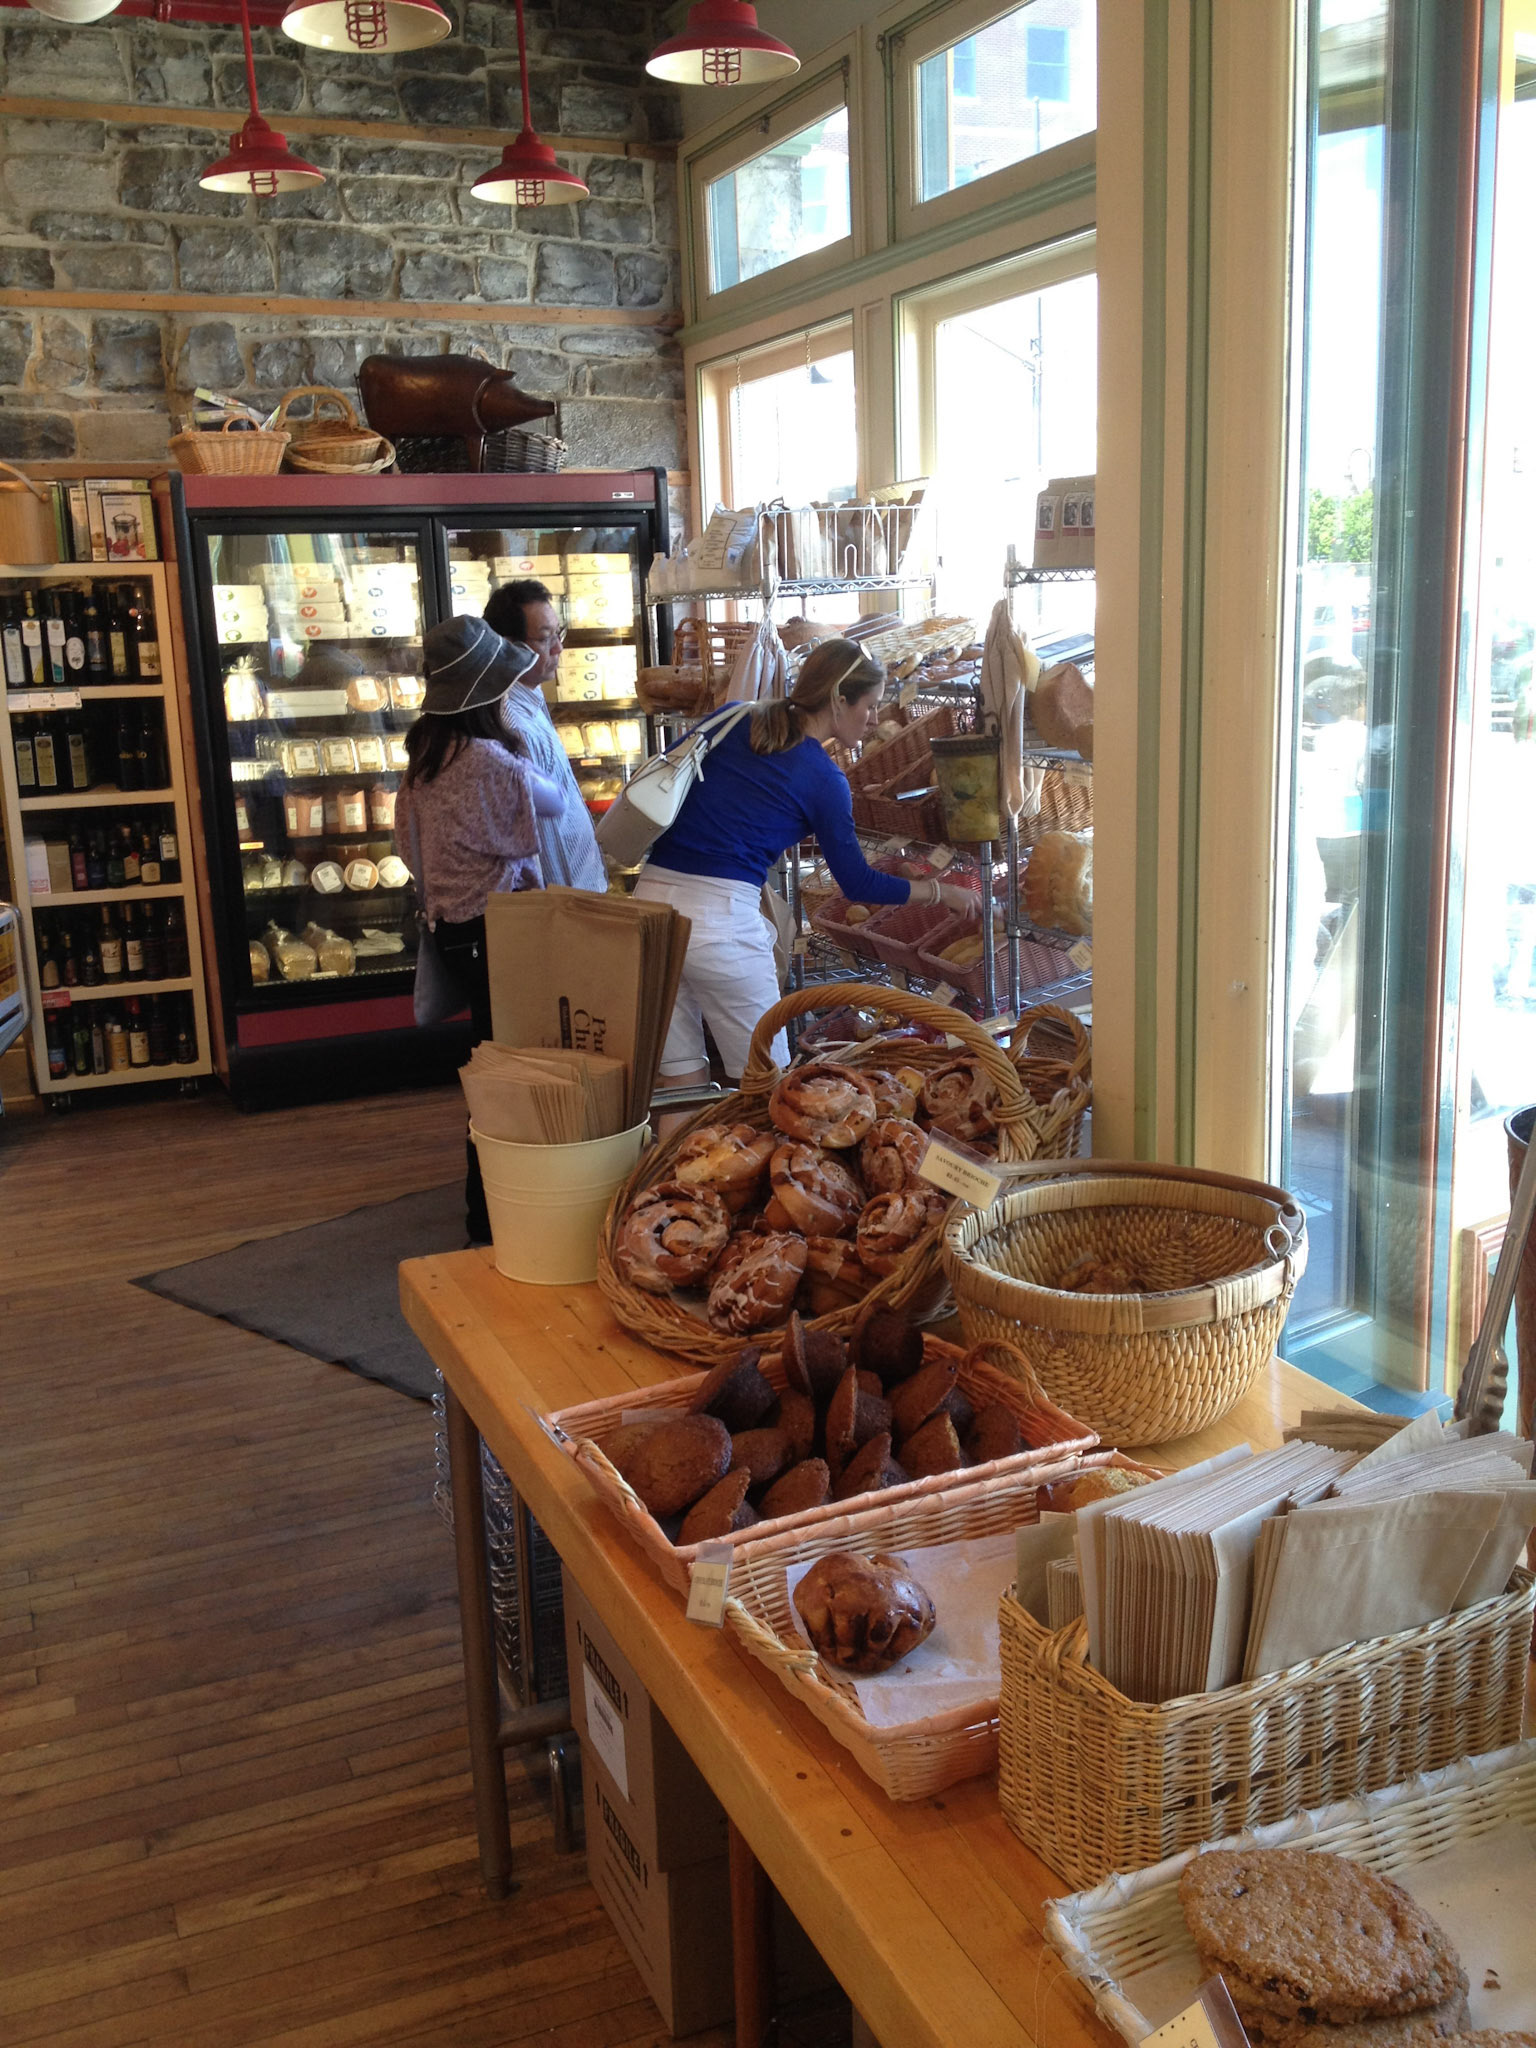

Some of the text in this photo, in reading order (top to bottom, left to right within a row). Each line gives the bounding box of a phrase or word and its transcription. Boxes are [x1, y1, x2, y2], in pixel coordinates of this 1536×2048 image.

[962, 1169, 990, 1188] BRIOCHE
[584, 1632, 622, 1713] FRAGILE
[603, 1795, 641, 1881] FRAGILE
